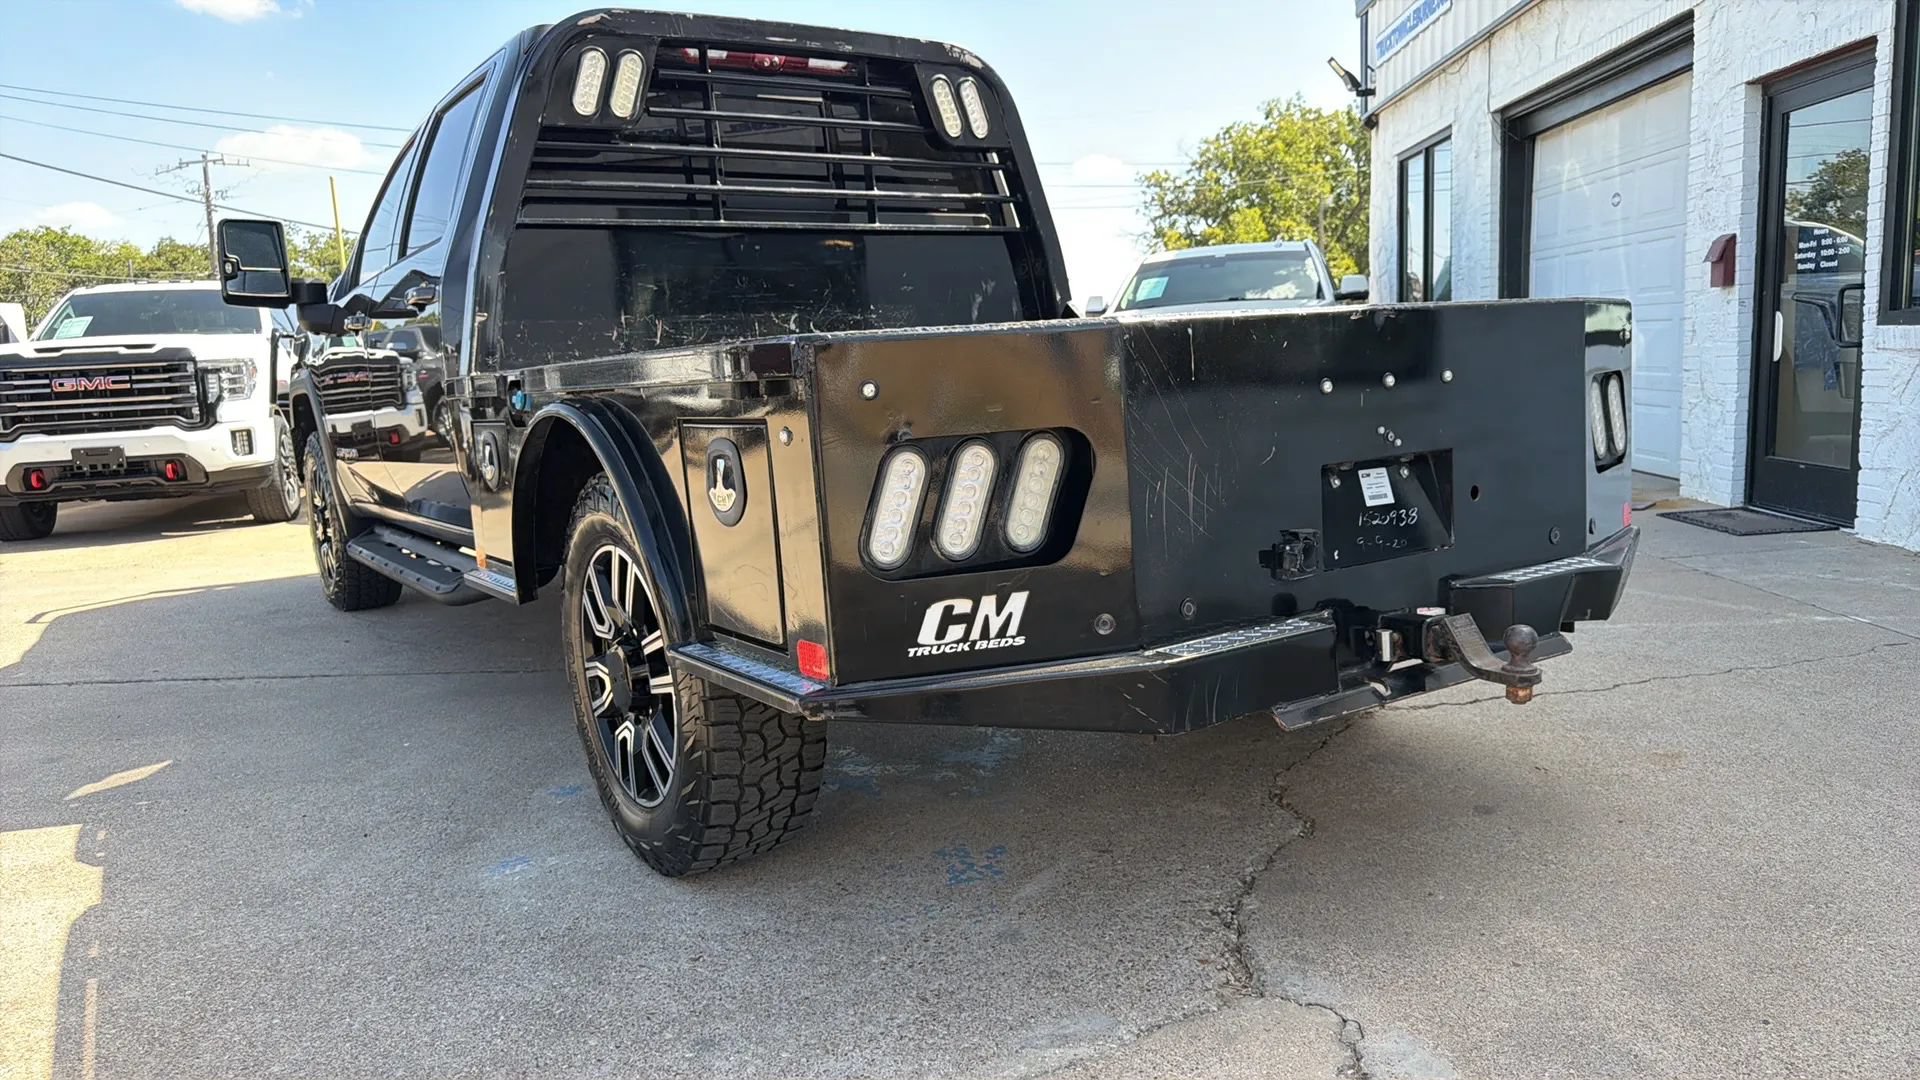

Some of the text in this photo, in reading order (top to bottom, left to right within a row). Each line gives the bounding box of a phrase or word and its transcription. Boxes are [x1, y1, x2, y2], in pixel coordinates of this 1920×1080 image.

[51, 375, 131, 392] GMC
[917, 590, 1030, 646] CM
[907, 635, 1027, 658] TRUCK BEDS
